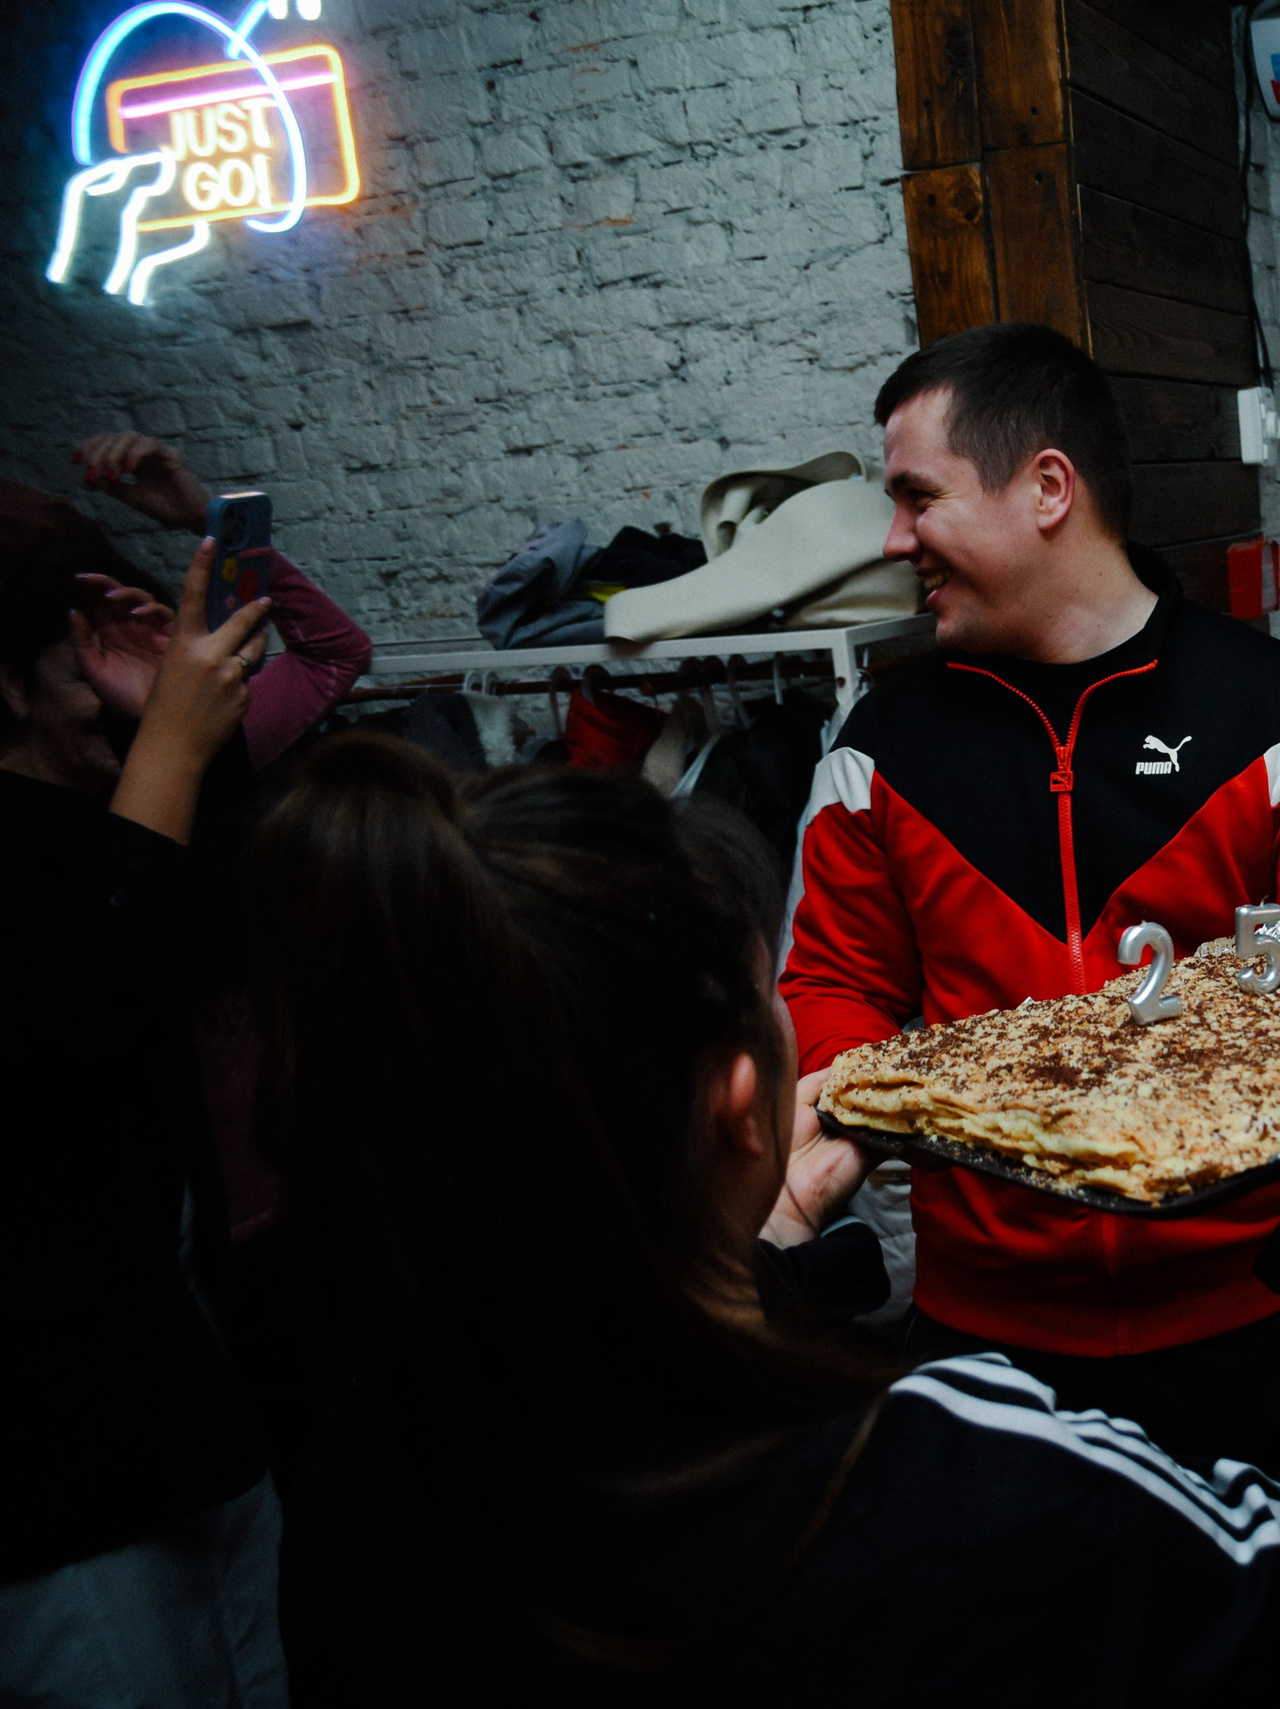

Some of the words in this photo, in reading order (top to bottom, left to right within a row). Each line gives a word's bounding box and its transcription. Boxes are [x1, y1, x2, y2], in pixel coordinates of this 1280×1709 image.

[162, 97, 278, 160] JUST
[183, 153, 273, 211] GO!
[1135, 761, 1173, 775] PUMA
